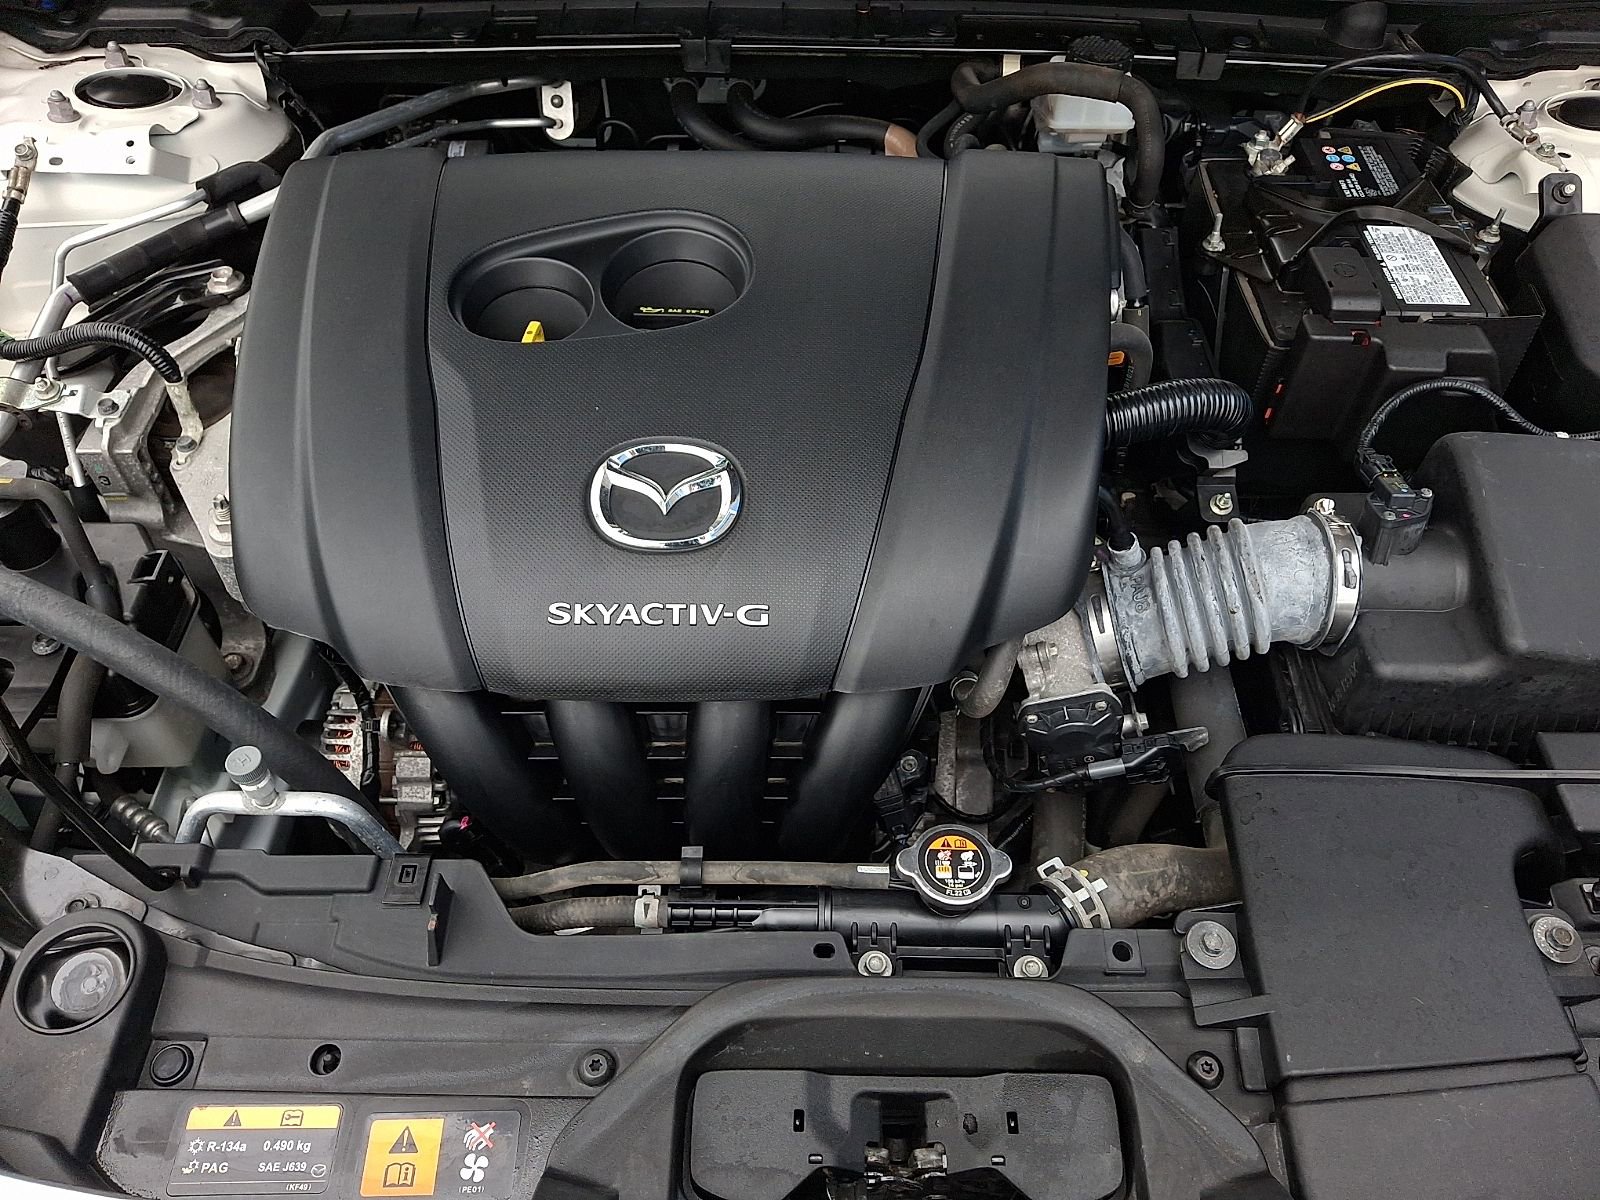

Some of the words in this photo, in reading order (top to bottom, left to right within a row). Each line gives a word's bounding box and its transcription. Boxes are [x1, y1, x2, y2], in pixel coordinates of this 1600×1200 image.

[547, 602, 770, 627] SKYACTIV-G
[206, 1140, 247, 1152] R-134a
[263, 1140, 294, 1152] 0.490
[296, 1140, 311, 1153] kg
[200, 1162, 229, 1174] PAG
[257, 1162, 281, 1172] SAE
[282, 1162, 307, 1172] J639
[285, 1183, 311, 1191] (KF49)
[458, 1185, 485, 1194] (PE01)
